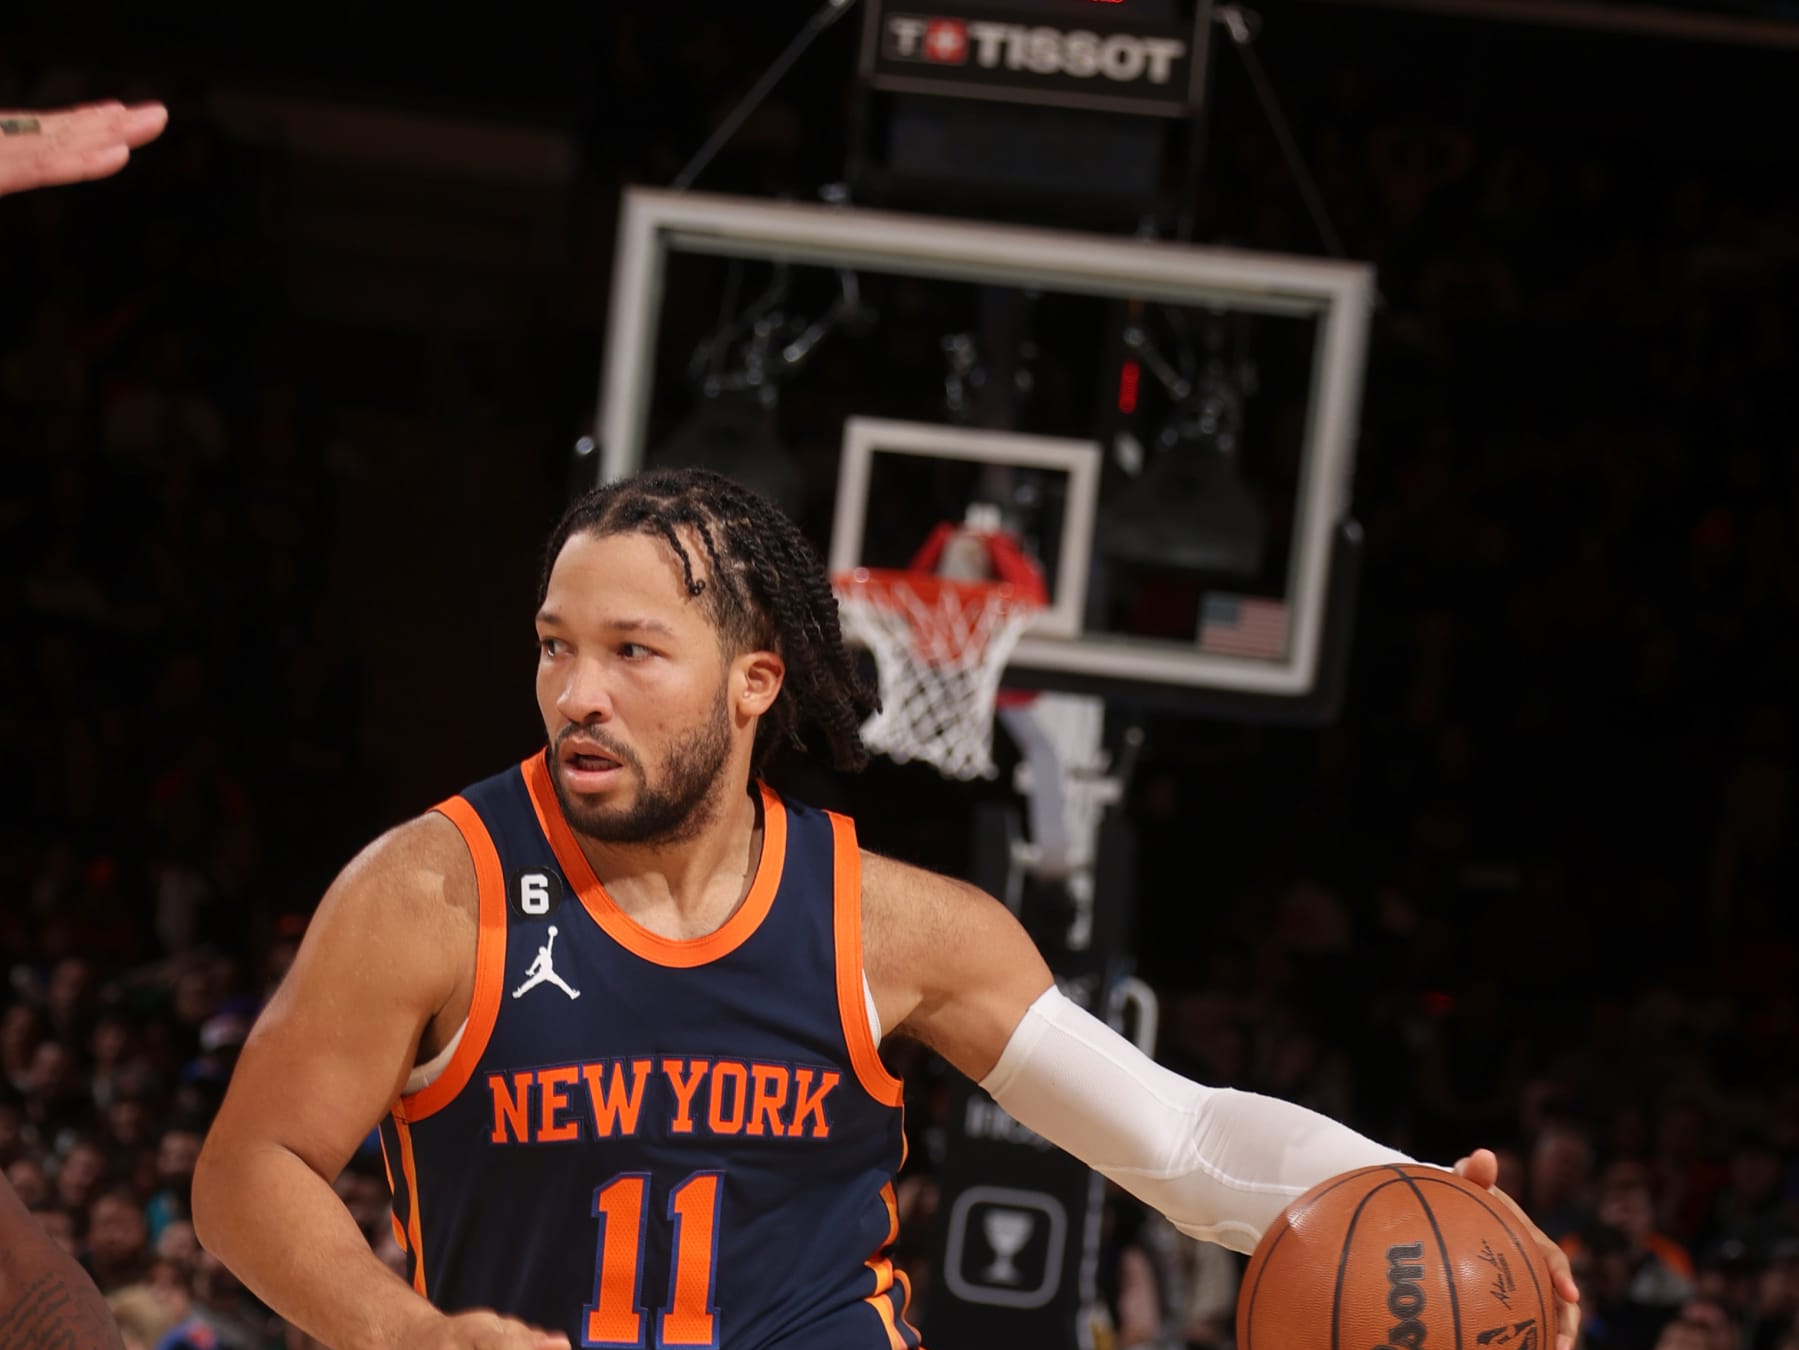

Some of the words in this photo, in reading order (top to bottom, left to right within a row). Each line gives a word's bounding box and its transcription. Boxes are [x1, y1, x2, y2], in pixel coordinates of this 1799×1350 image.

[969, 20, 1186, 84] TISSOT
[520, 873, 550, 915] 6
[485, 1056, 653, 1144] NEW
[661, 1055, 842, 1140] YORK
[580, 1169, 727, 1350] 11
